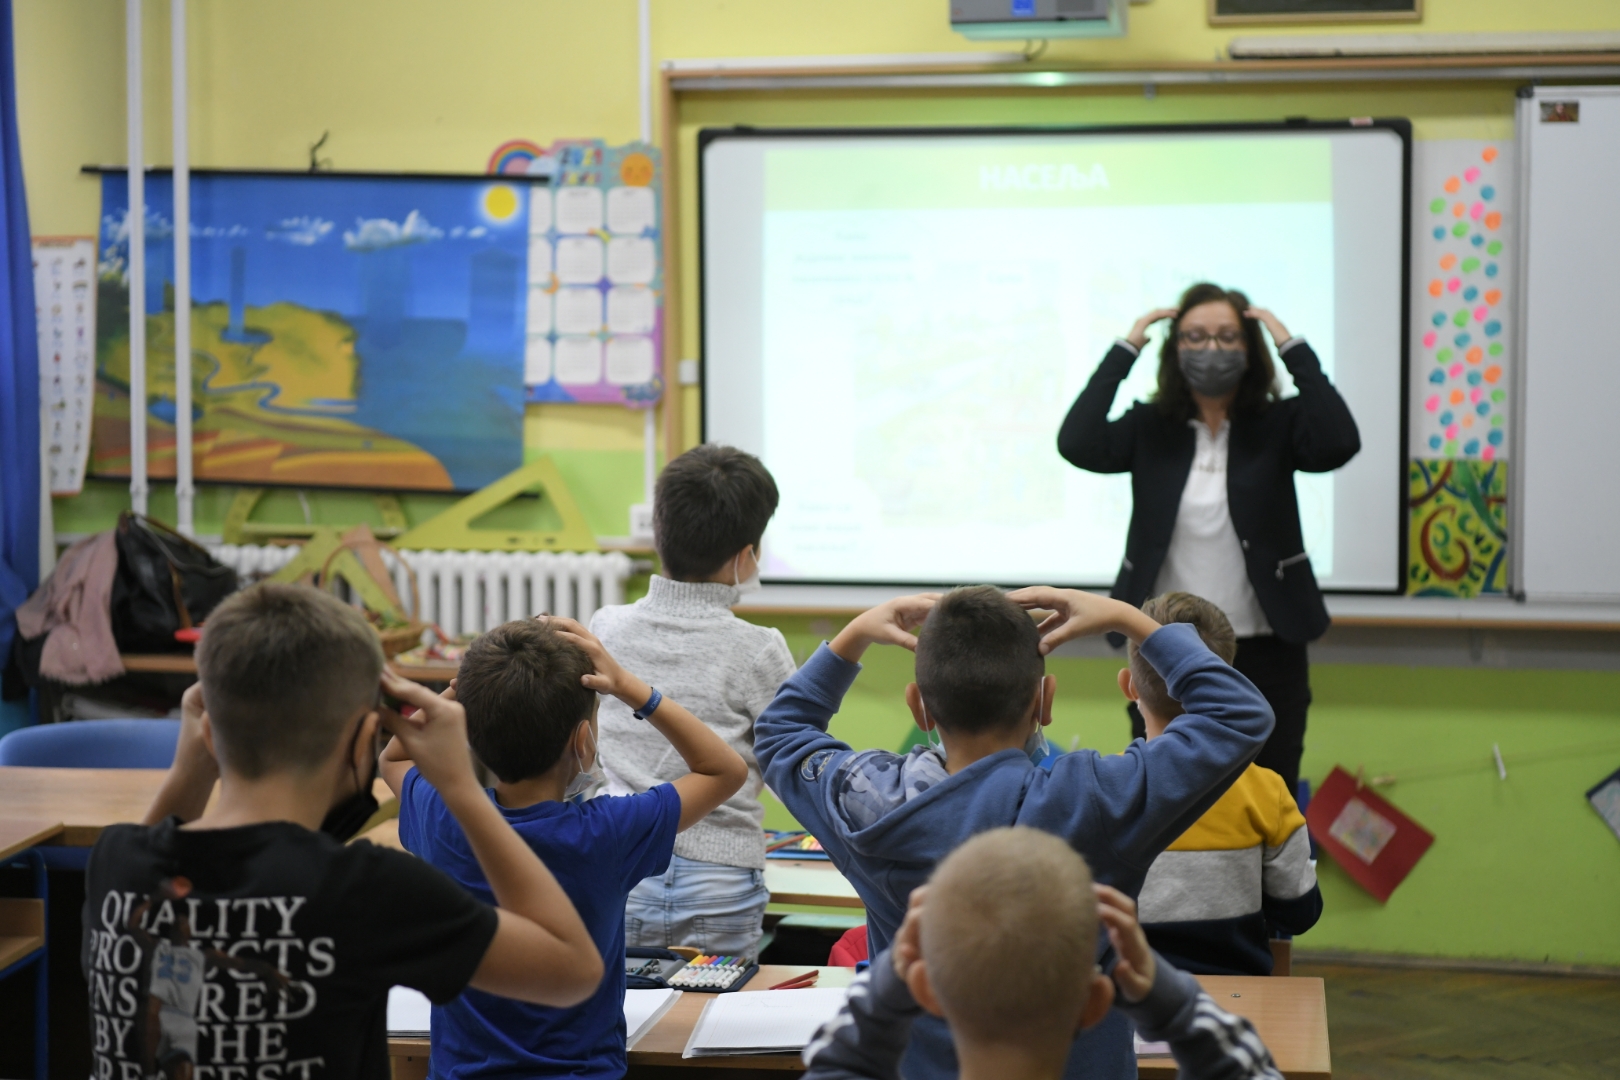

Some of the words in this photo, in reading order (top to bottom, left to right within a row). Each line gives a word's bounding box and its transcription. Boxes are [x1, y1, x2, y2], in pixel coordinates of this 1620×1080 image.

[979, 164, 1110, 190] НАСЕЉА
[90, 929, 336, 978] PROCTS
[95, 1014, 134, 1058] BY
[197, 1022, 288, 1063] HE
